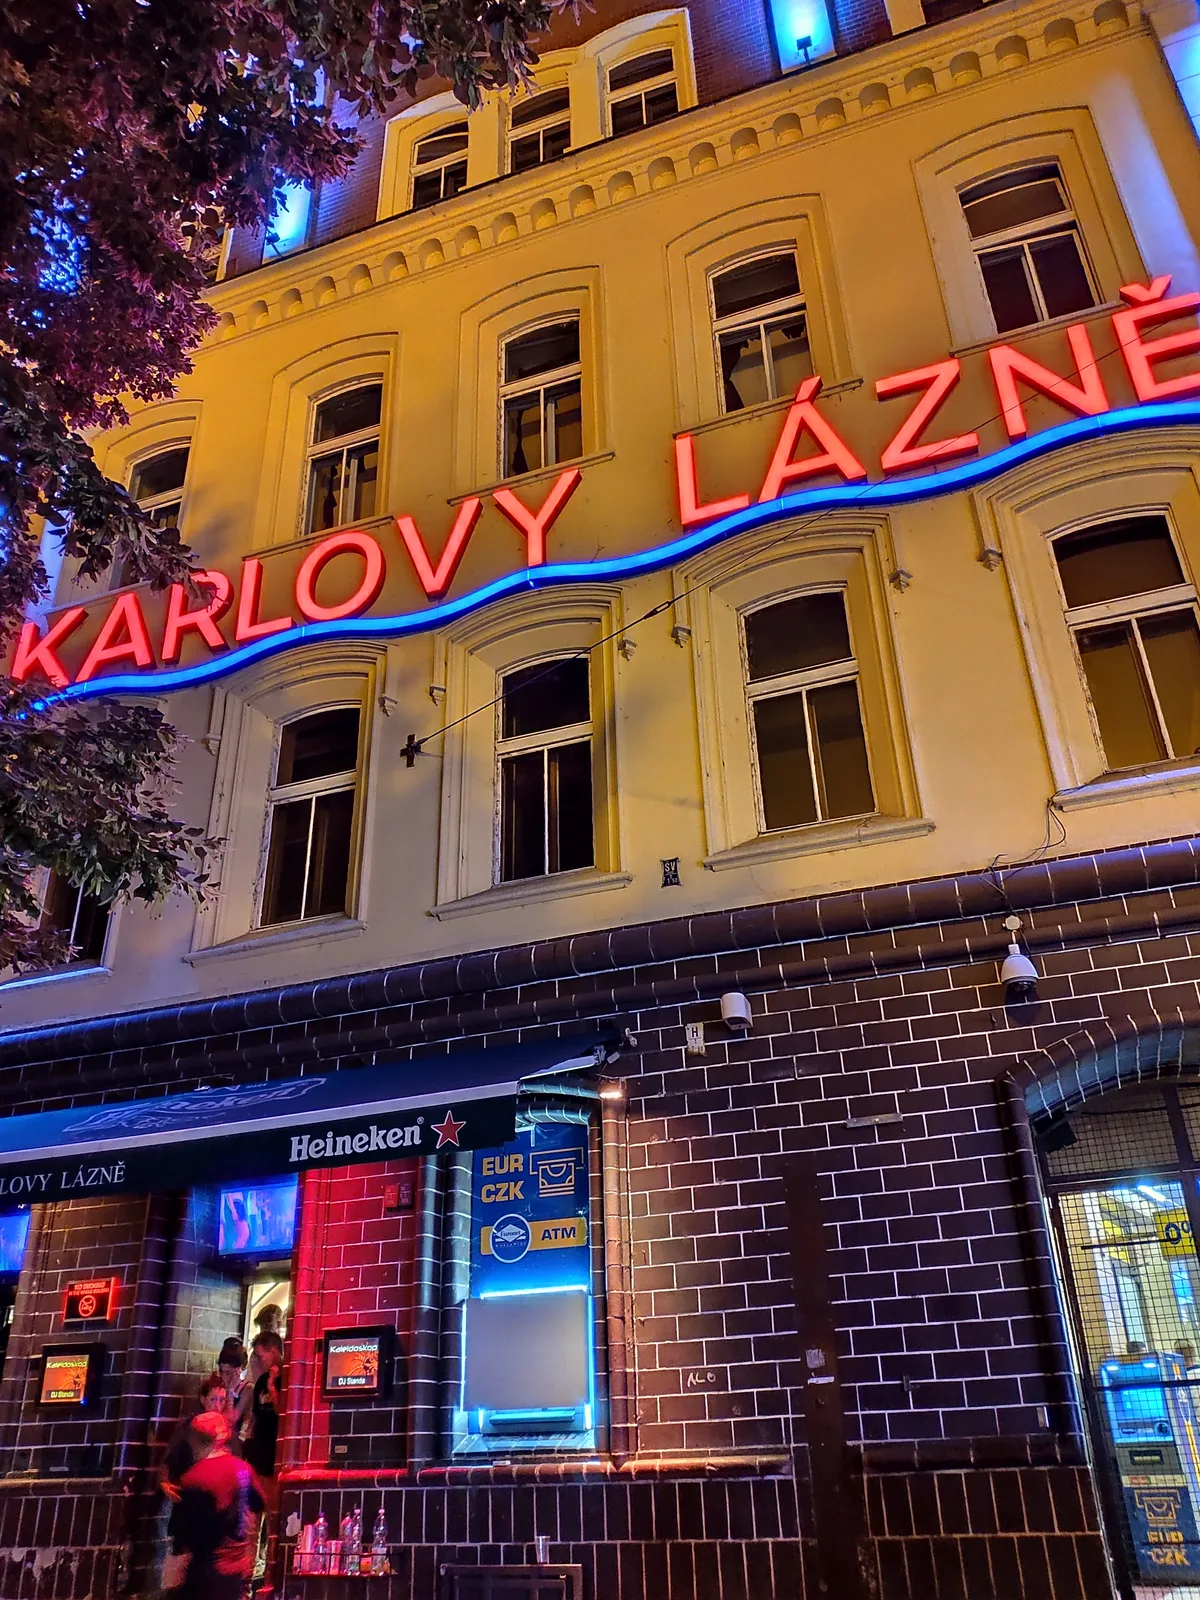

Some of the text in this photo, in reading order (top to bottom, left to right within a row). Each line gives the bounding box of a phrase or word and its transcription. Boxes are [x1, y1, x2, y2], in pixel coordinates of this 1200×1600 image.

[11, 274, 1200, 688] KARLOVY LÁZNĚ
[288, 1124, 422, 1162] Heineken
[60, 1160, 126, 1189] LÁZNĚ
[482, 1153, 524, 1176] EUR
[481, 1181, 524, 1203] CZK
[541, 1226, 577, 1241] ATM
[329, 1344, 379, 1353] Kaleidoskop
